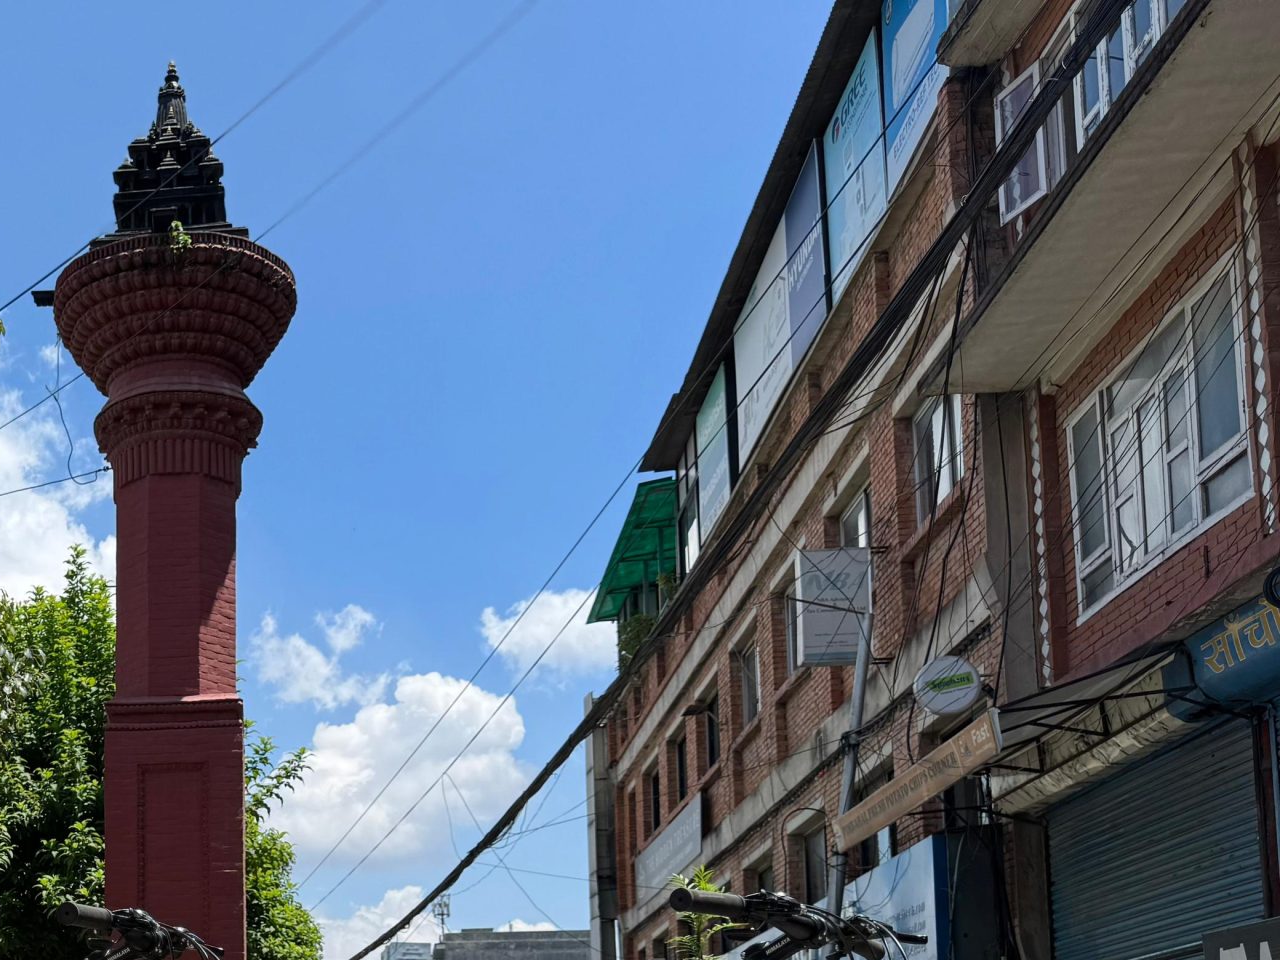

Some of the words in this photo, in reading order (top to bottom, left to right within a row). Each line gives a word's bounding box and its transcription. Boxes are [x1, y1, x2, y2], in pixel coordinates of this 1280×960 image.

[840, 59, 866, 126] GREE
[788, 214, 822, 291] HYUNDAI
[971, 724, 990, 747] Fast
[765, 937, 791, 956] HIMALAYA
